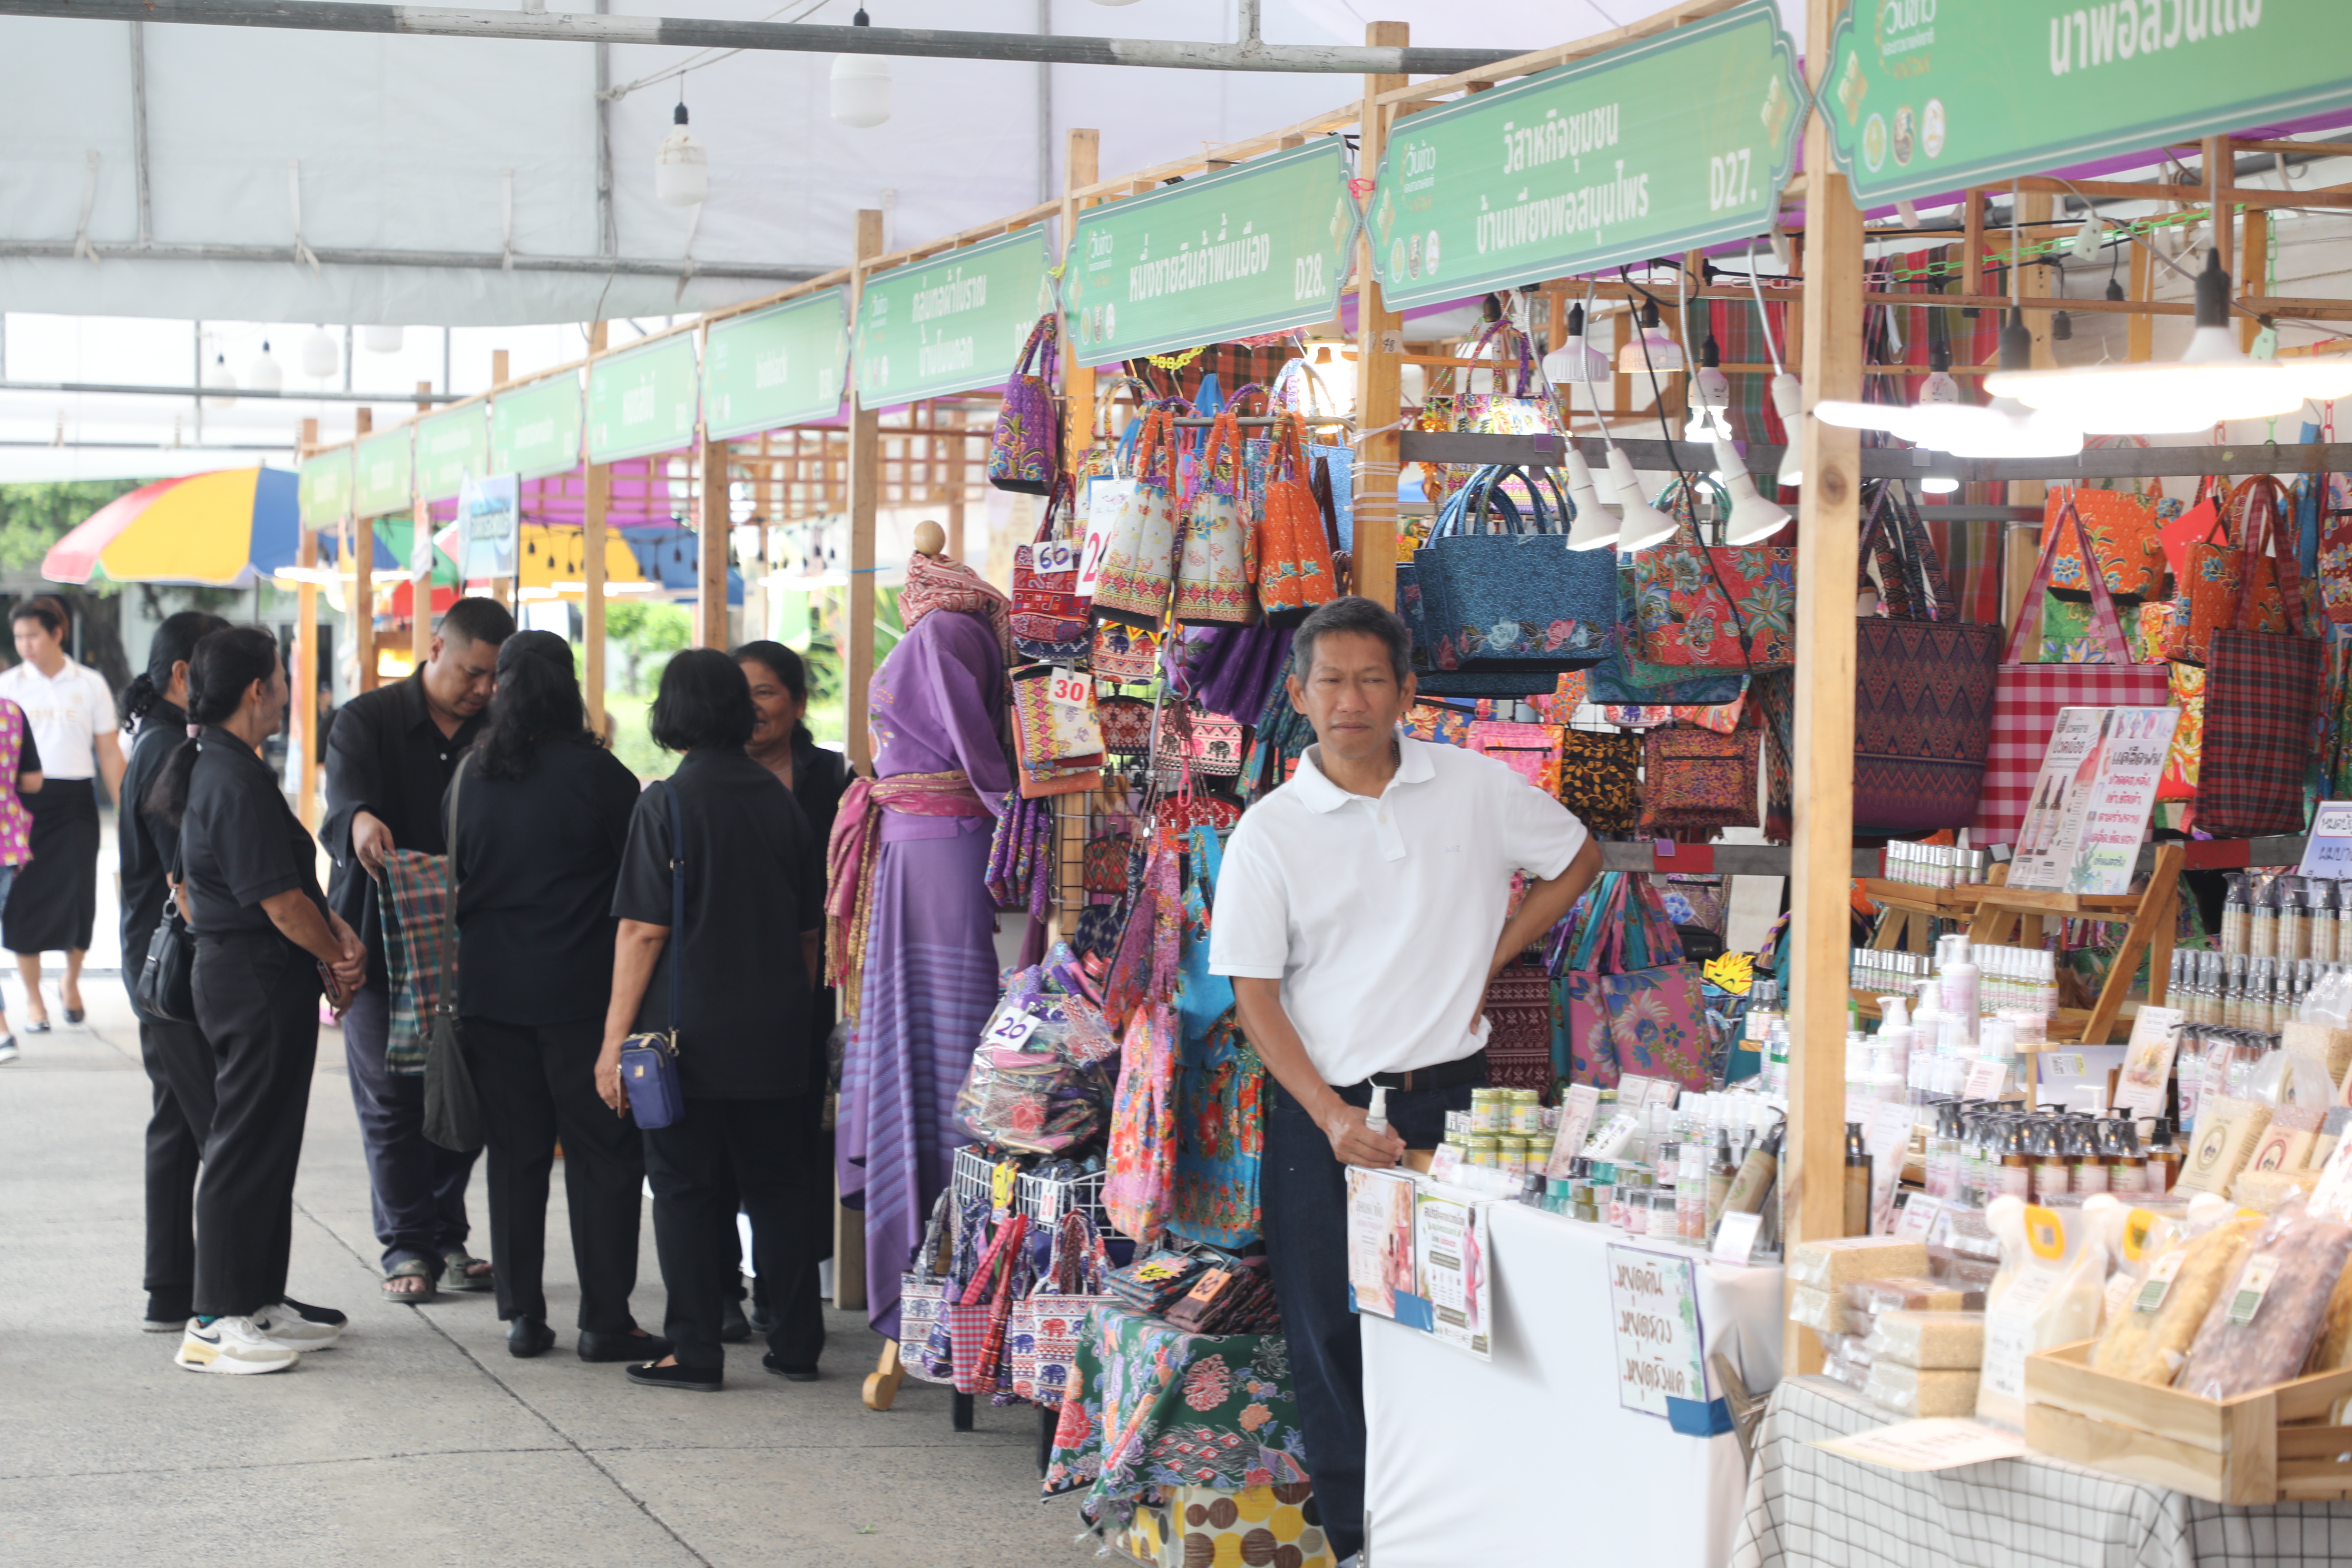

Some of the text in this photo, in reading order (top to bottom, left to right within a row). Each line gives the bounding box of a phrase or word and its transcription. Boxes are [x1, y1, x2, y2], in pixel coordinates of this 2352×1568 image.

[1504, 103, 1619, 173] วิสาหกิจชุมชน
[1710, 149, 1757, 211] D27.
[1477, 159, 1649, 254] บ้านเพียงพอสมุนไพร
[1295, 253, 1326, 300] D28.
[1039, 546, 1069, 570] 60
[1054, 679, 1084, 702] 30
[995, 1017, 1027, 1040] 20
